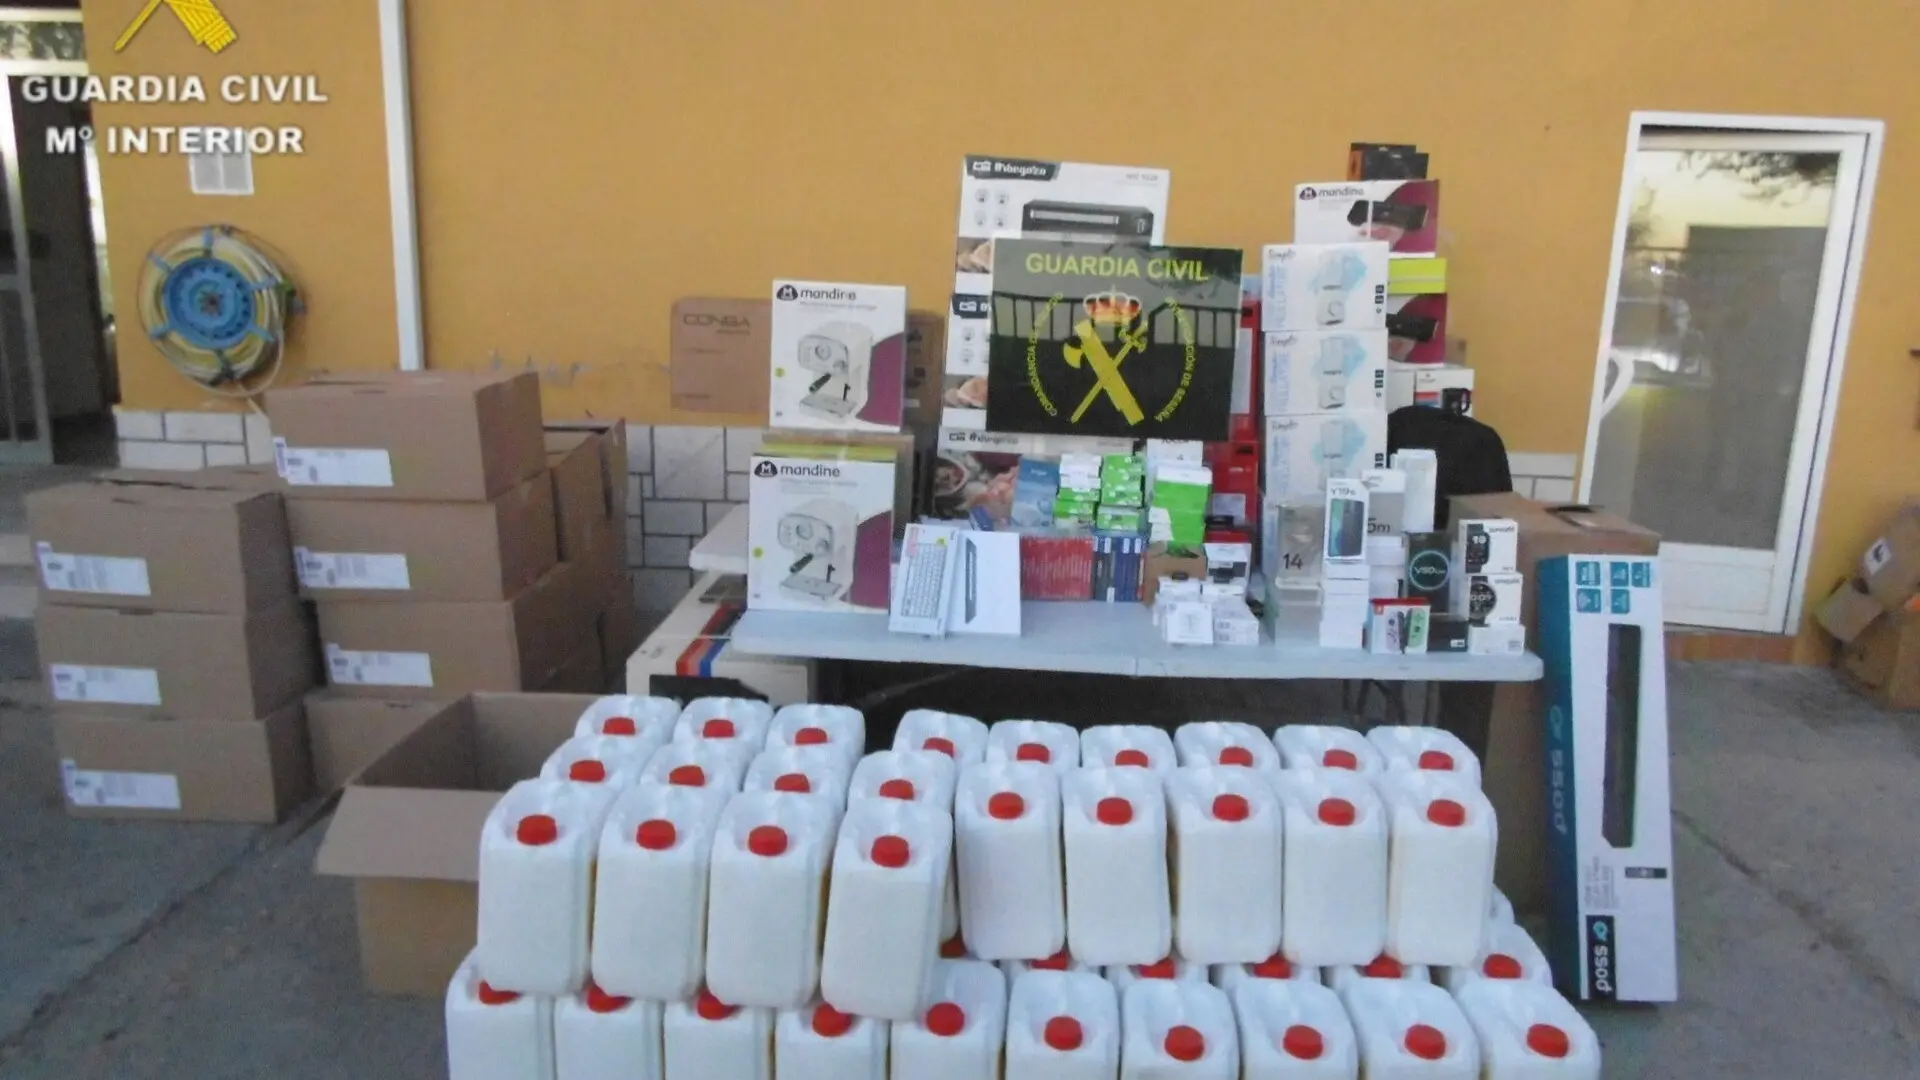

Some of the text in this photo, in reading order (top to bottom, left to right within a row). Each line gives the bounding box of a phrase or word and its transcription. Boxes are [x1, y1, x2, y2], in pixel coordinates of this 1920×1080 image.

[1025, 253, 1209, 282] GUARDIA CIVIL
[800, 288, 857, 301] mandine
[1027, 343, 1059, 417] COMANDANCIA
[780, 464, 840, 478] mandine
[1283, 553, 1302, 570] 14
[1594, 945, 1613, 993] poss
